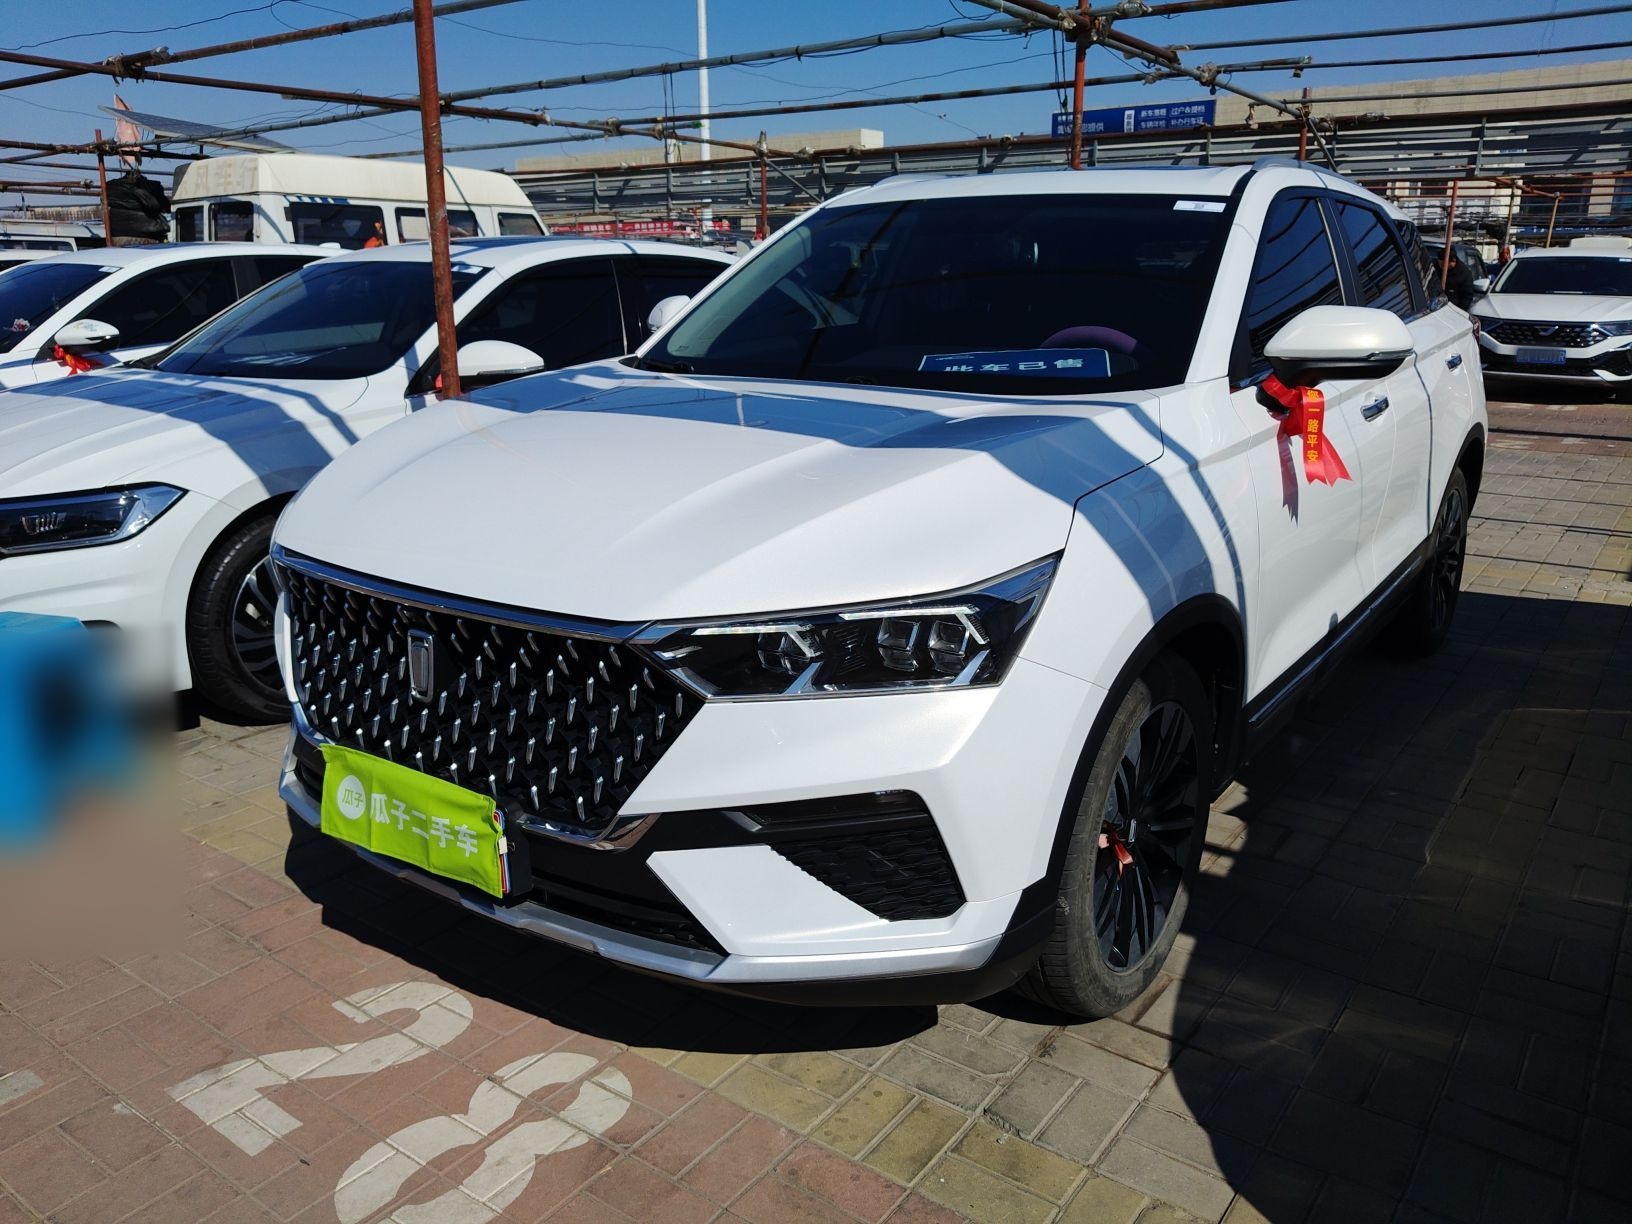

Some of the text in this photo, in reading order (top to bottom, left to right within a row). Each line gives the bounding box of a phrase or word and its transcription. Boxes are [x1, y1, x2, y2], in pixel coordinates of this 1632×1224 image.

[341, 789, 364, 809] 瓜子
[370, 793, 478, 857] 瓜子二手车
